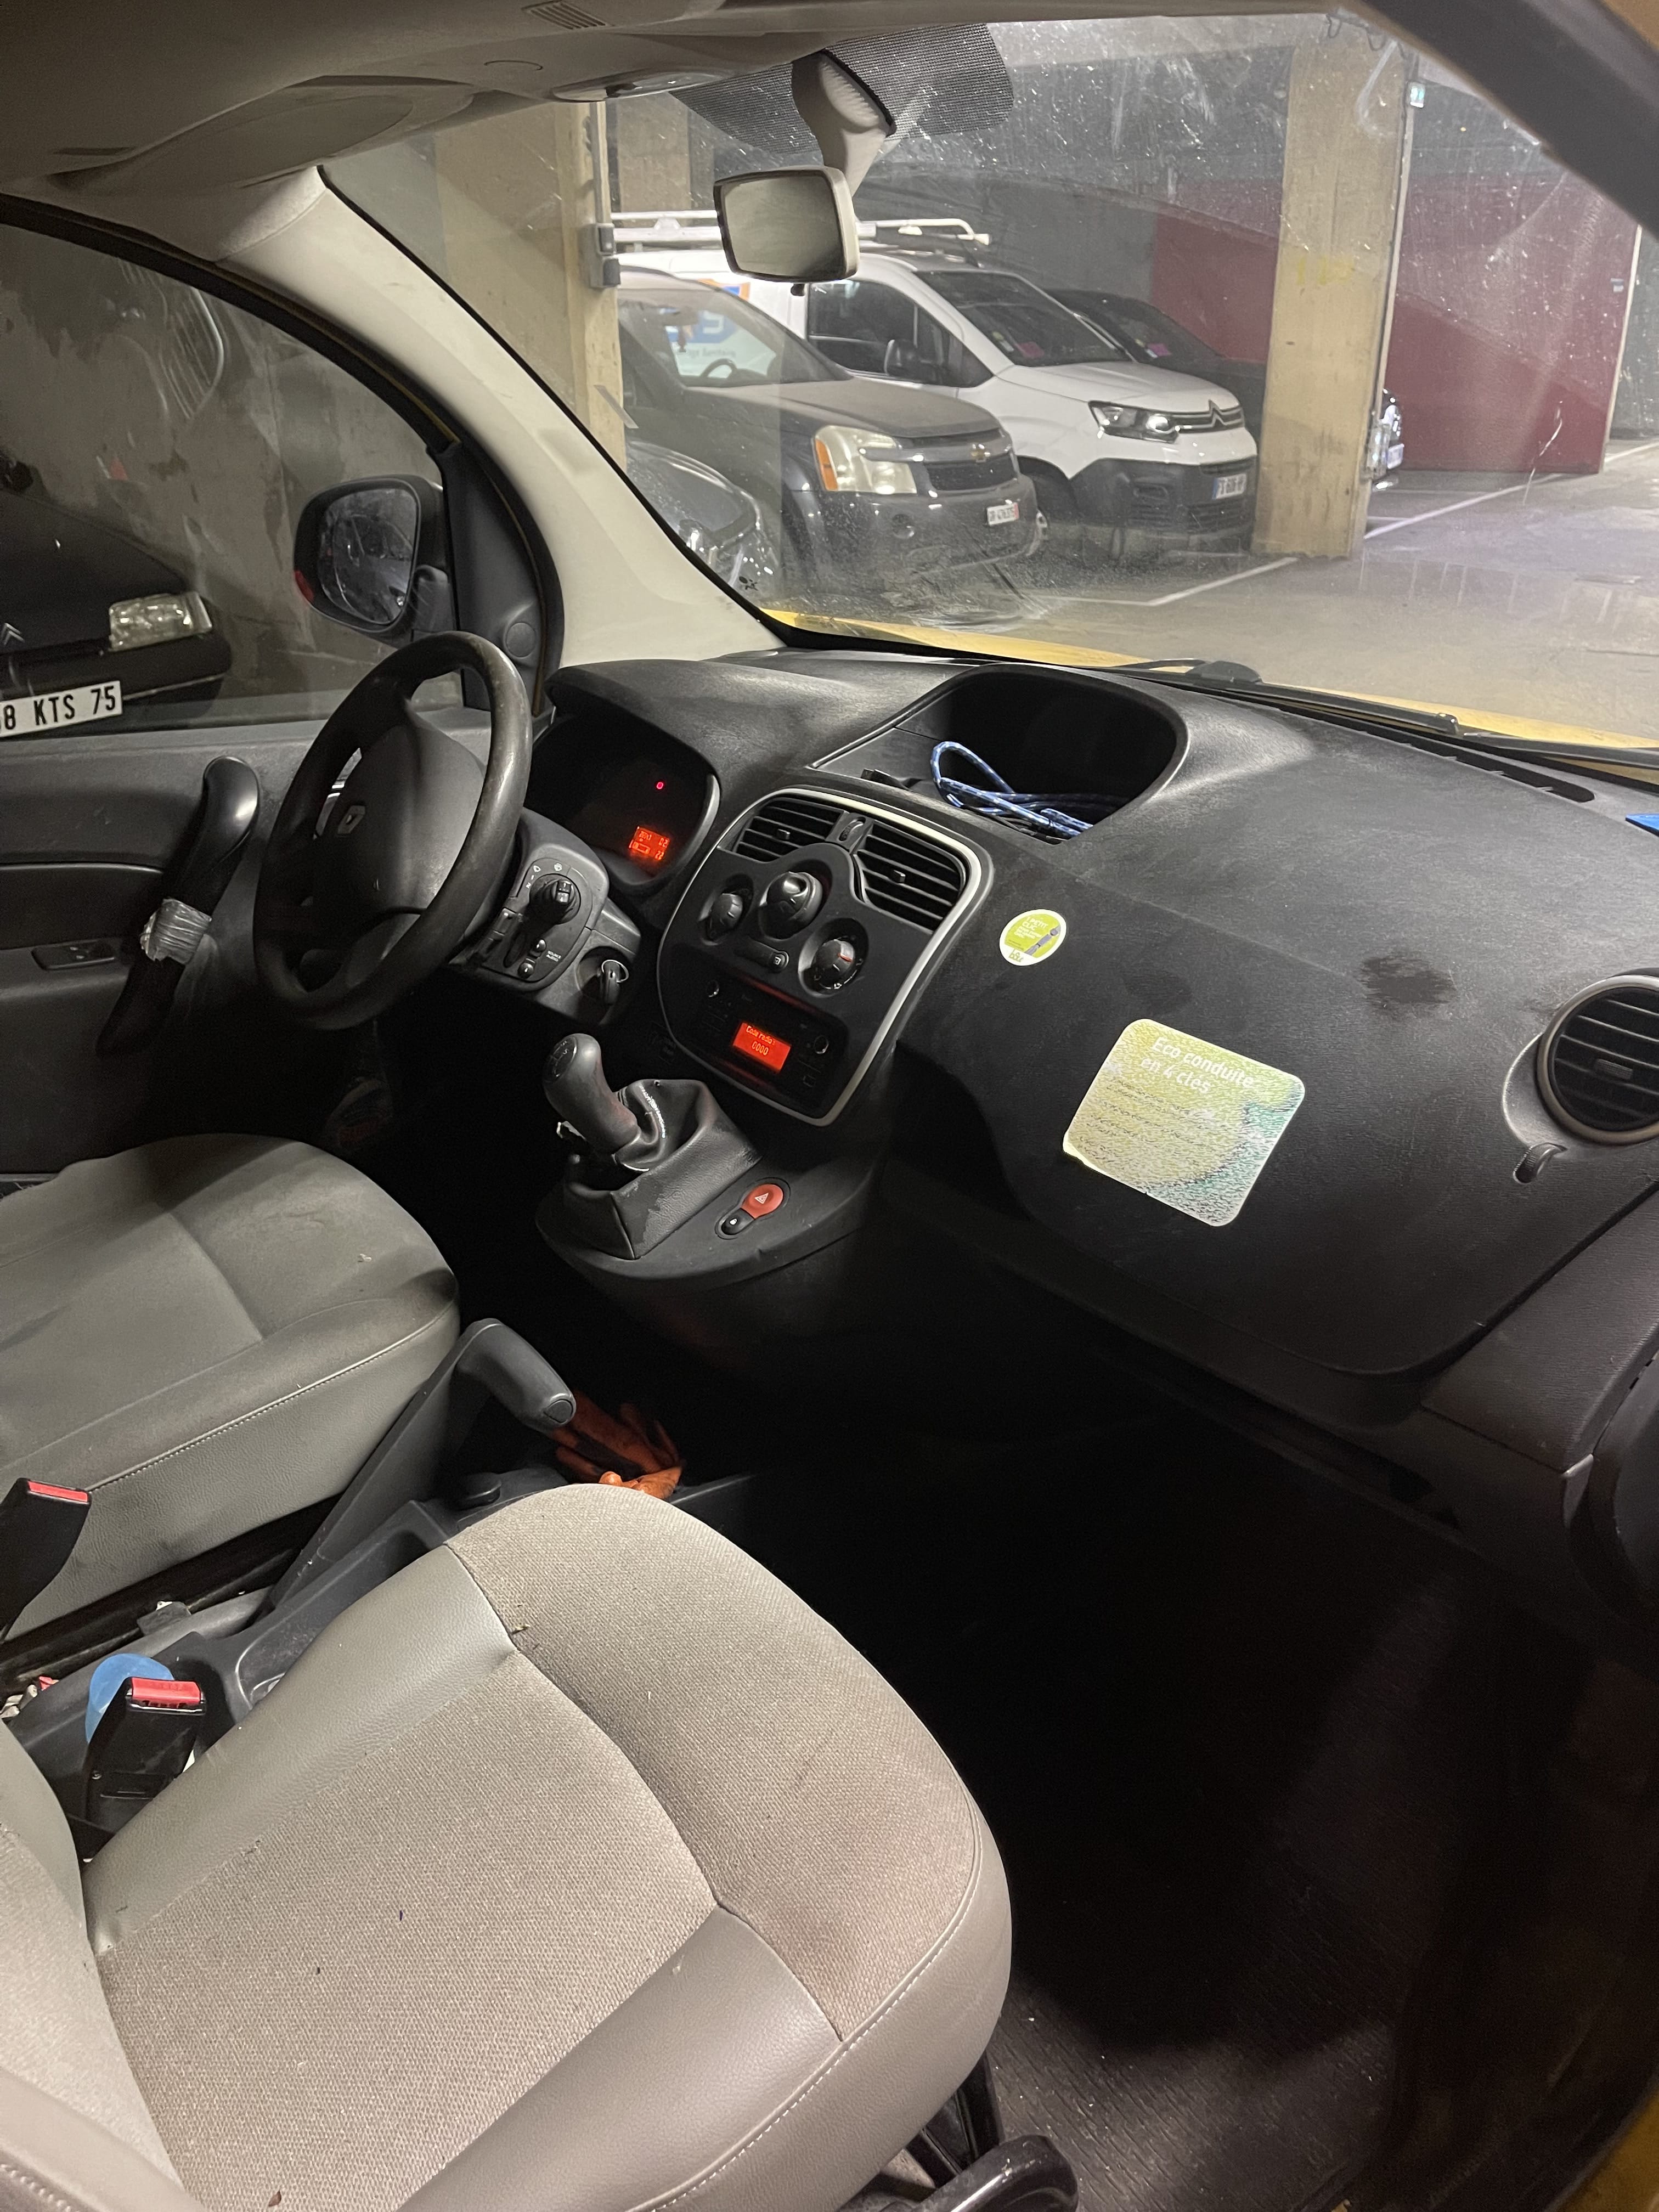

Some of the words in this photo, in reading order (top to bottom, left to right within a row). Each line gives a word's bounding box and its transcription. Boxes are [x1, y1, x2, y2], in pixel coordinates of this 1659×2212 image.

[0, 704, 16, 730] 8
[33, 694, 75, 726] KTS
[91, 685, 115, 715] 75
[746, 1025, 759, 1037] Code
[752, 1041, 769, 1055] 0000
[1141, 1058, 1161, 1072] en
[1163, 1065, 1175, 1078] 4
[1183, 1053, 1254, 1088] conduite
